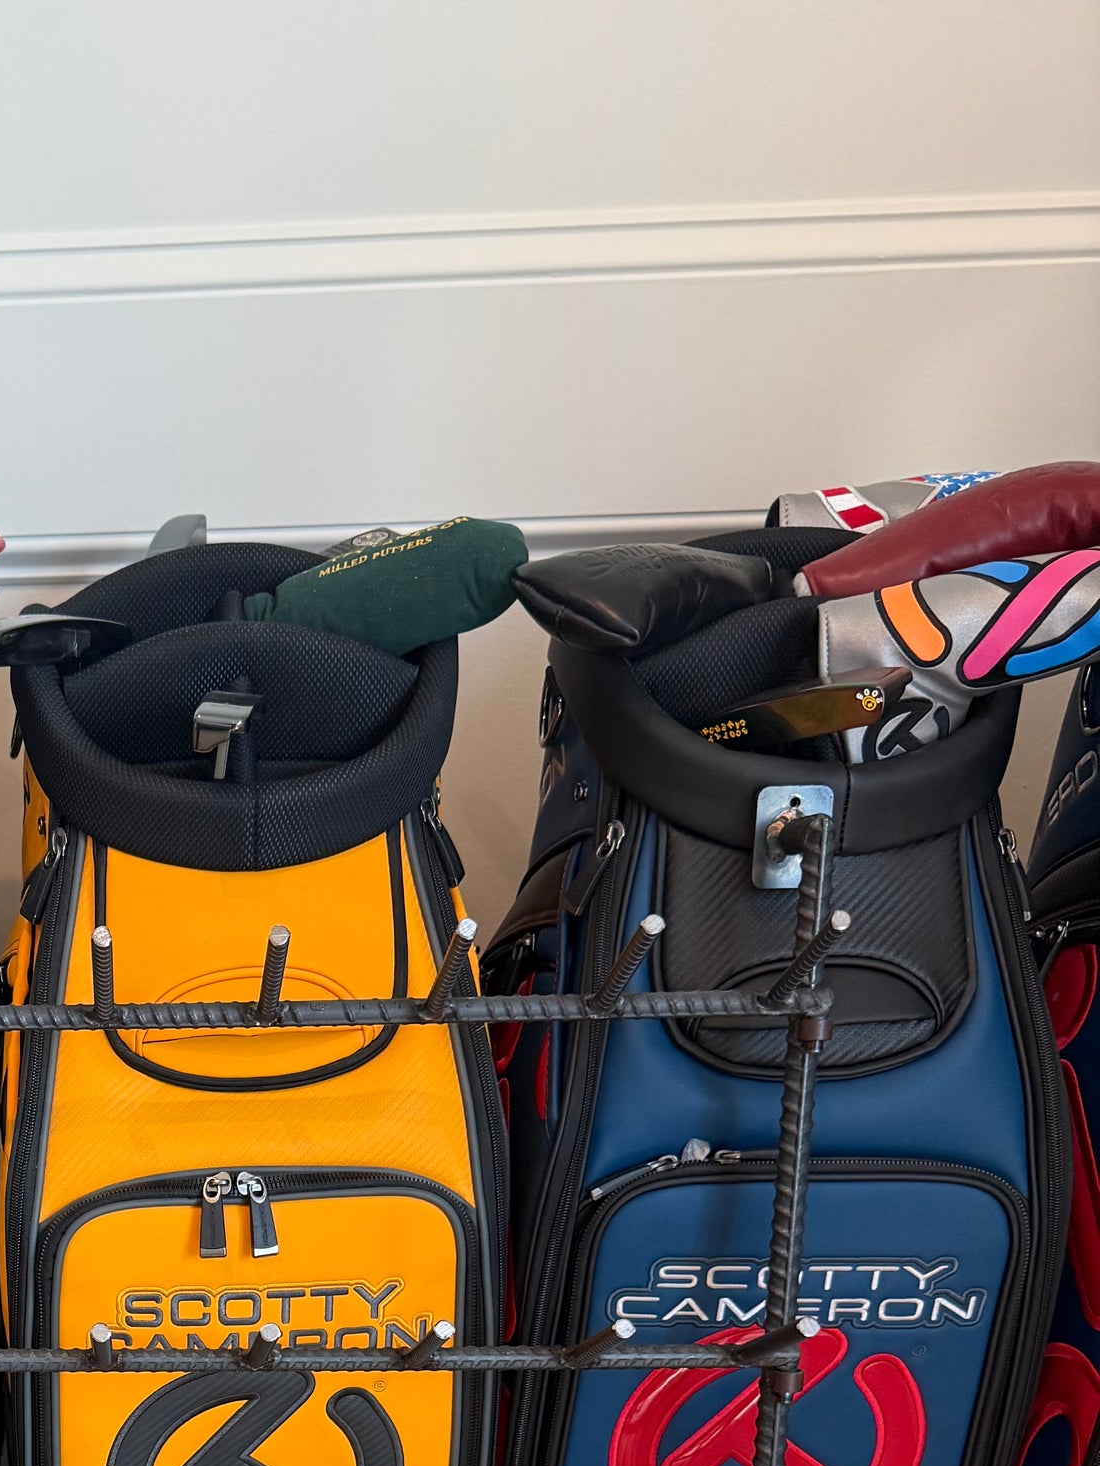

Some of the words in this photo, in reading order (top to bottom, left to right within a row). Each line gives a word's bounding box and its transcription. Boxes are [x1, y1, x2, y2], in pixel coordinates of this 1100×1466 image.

[318, 555, 368, 578] MILLED
[371, 536, 433, 560] PUTTERS
[701, 719, 747, 736] CAMERON
[707, 727, 749, 743] SCOTTY
[124, 1283, 399, 1327] SCOTTY
